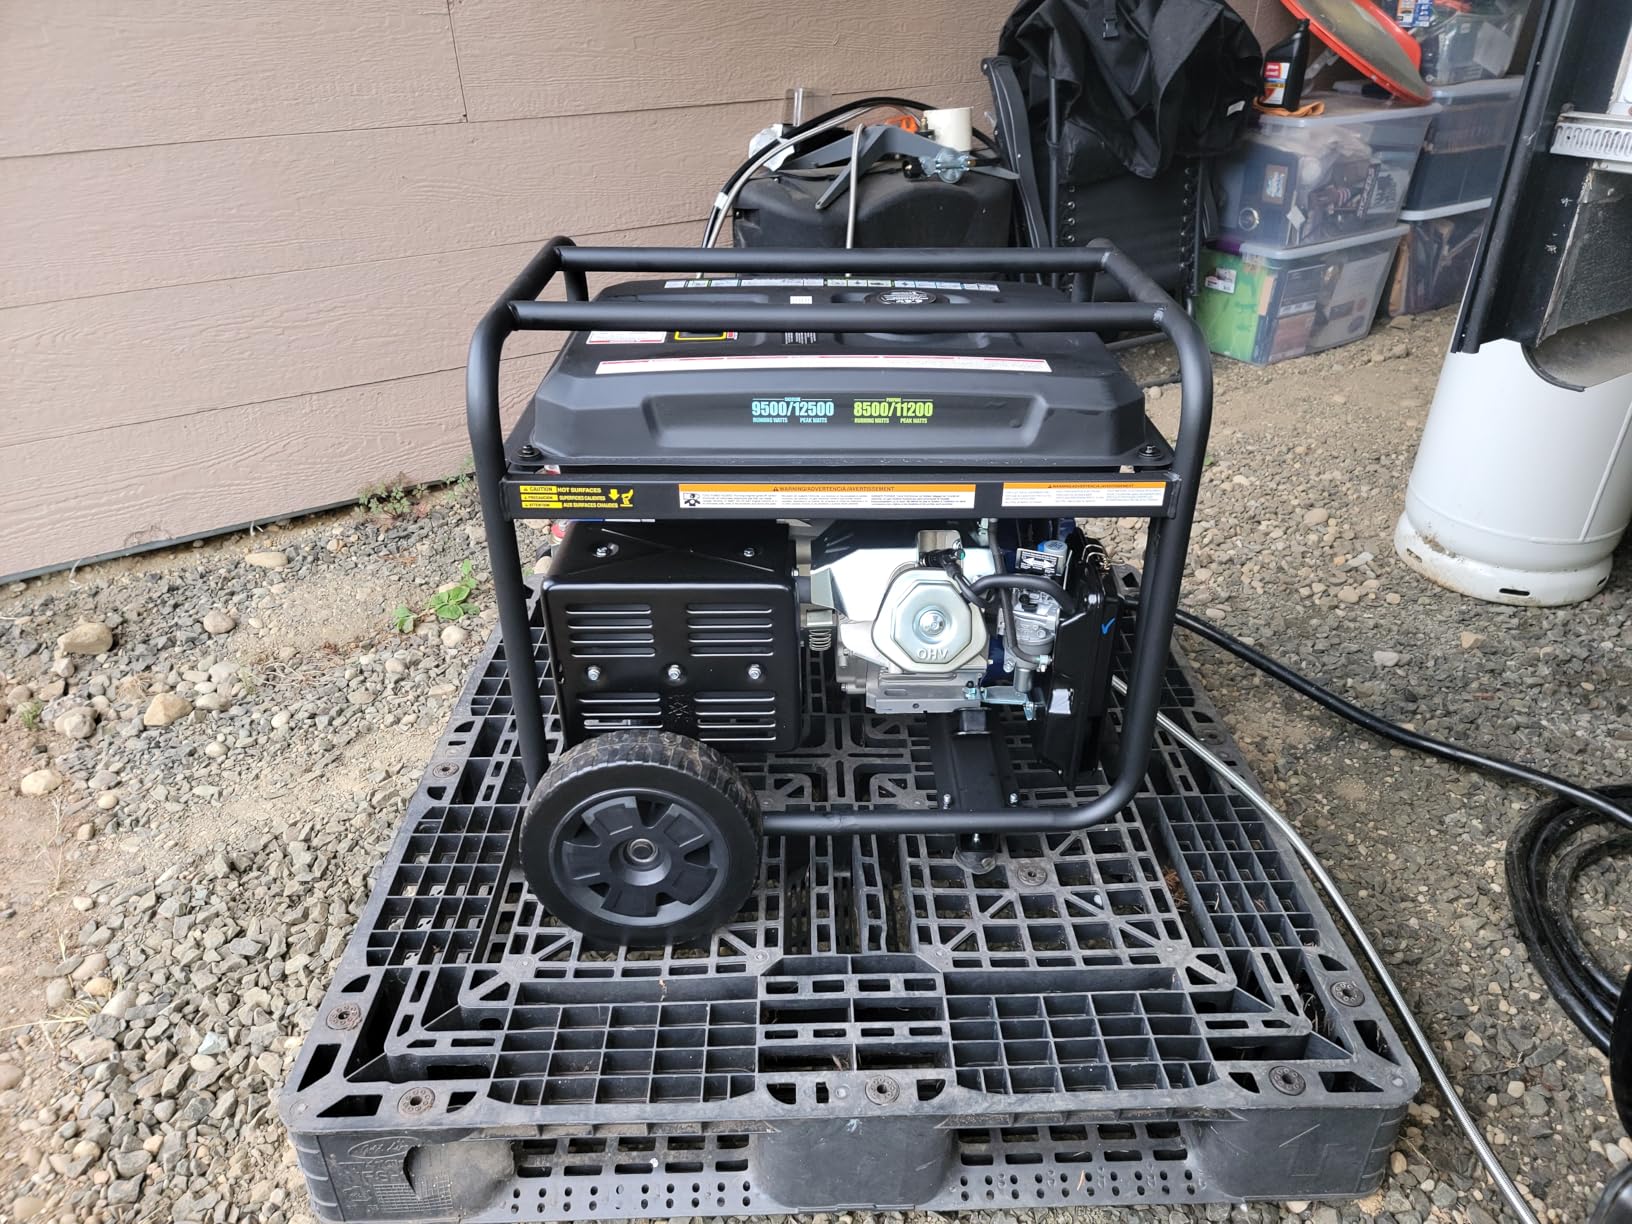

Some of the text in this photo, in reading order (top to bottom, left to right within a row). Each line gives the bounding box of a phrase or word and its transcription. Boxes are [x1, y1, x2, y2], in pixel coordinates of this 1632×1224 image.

[752, 401, 834, 416] 9500/12500
[853, 402, 933, 416] 8500/11200
[918, 648, 949, 660] OHV
